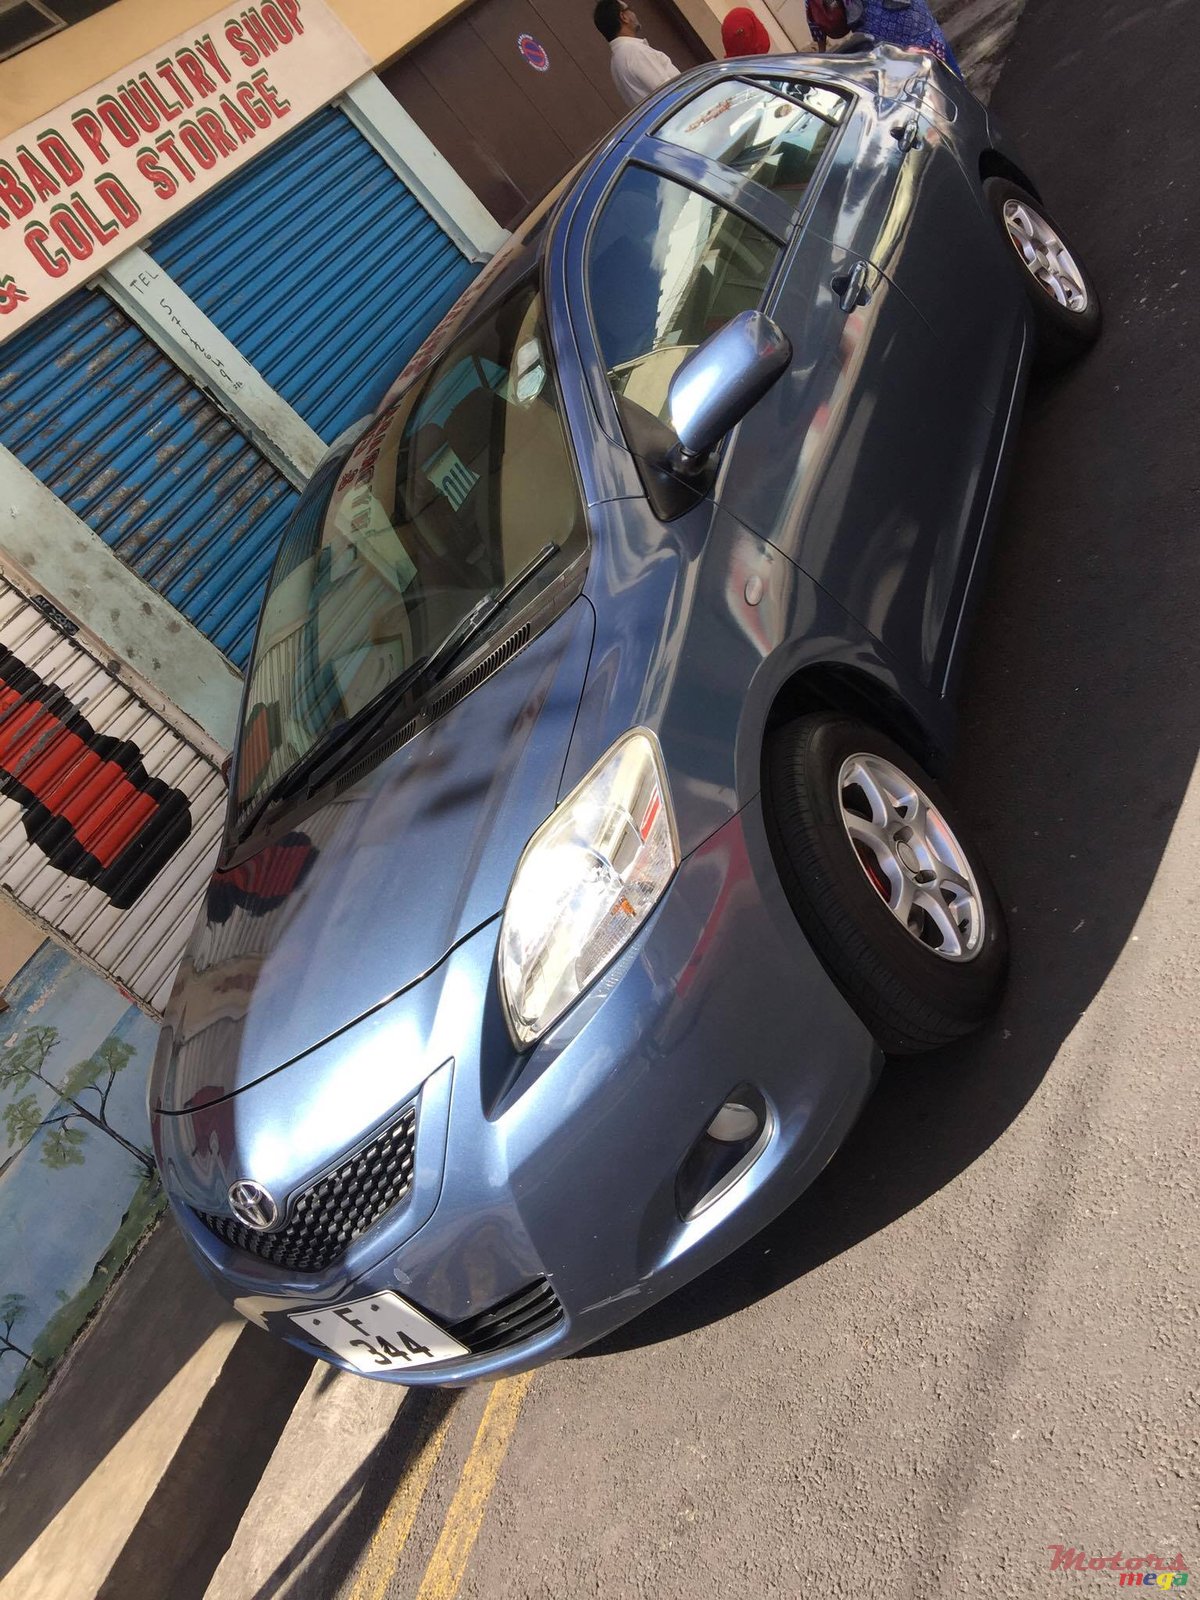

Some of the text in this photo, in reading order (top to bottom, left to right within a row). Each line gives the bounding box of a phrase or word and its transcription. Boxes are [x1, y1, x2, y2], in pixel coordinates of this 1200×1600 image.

[71, 34, 232, 165] POULTRY
[224, 0, 304, 67] SHOP
[24, 172, 142, 279] COLD
[136, 68, 291, 200] STORAGE
[129, 270, 159, 295] TEL
[333, 1307, 371, 1337] F
[350, 1331, 434, 1366] 344
